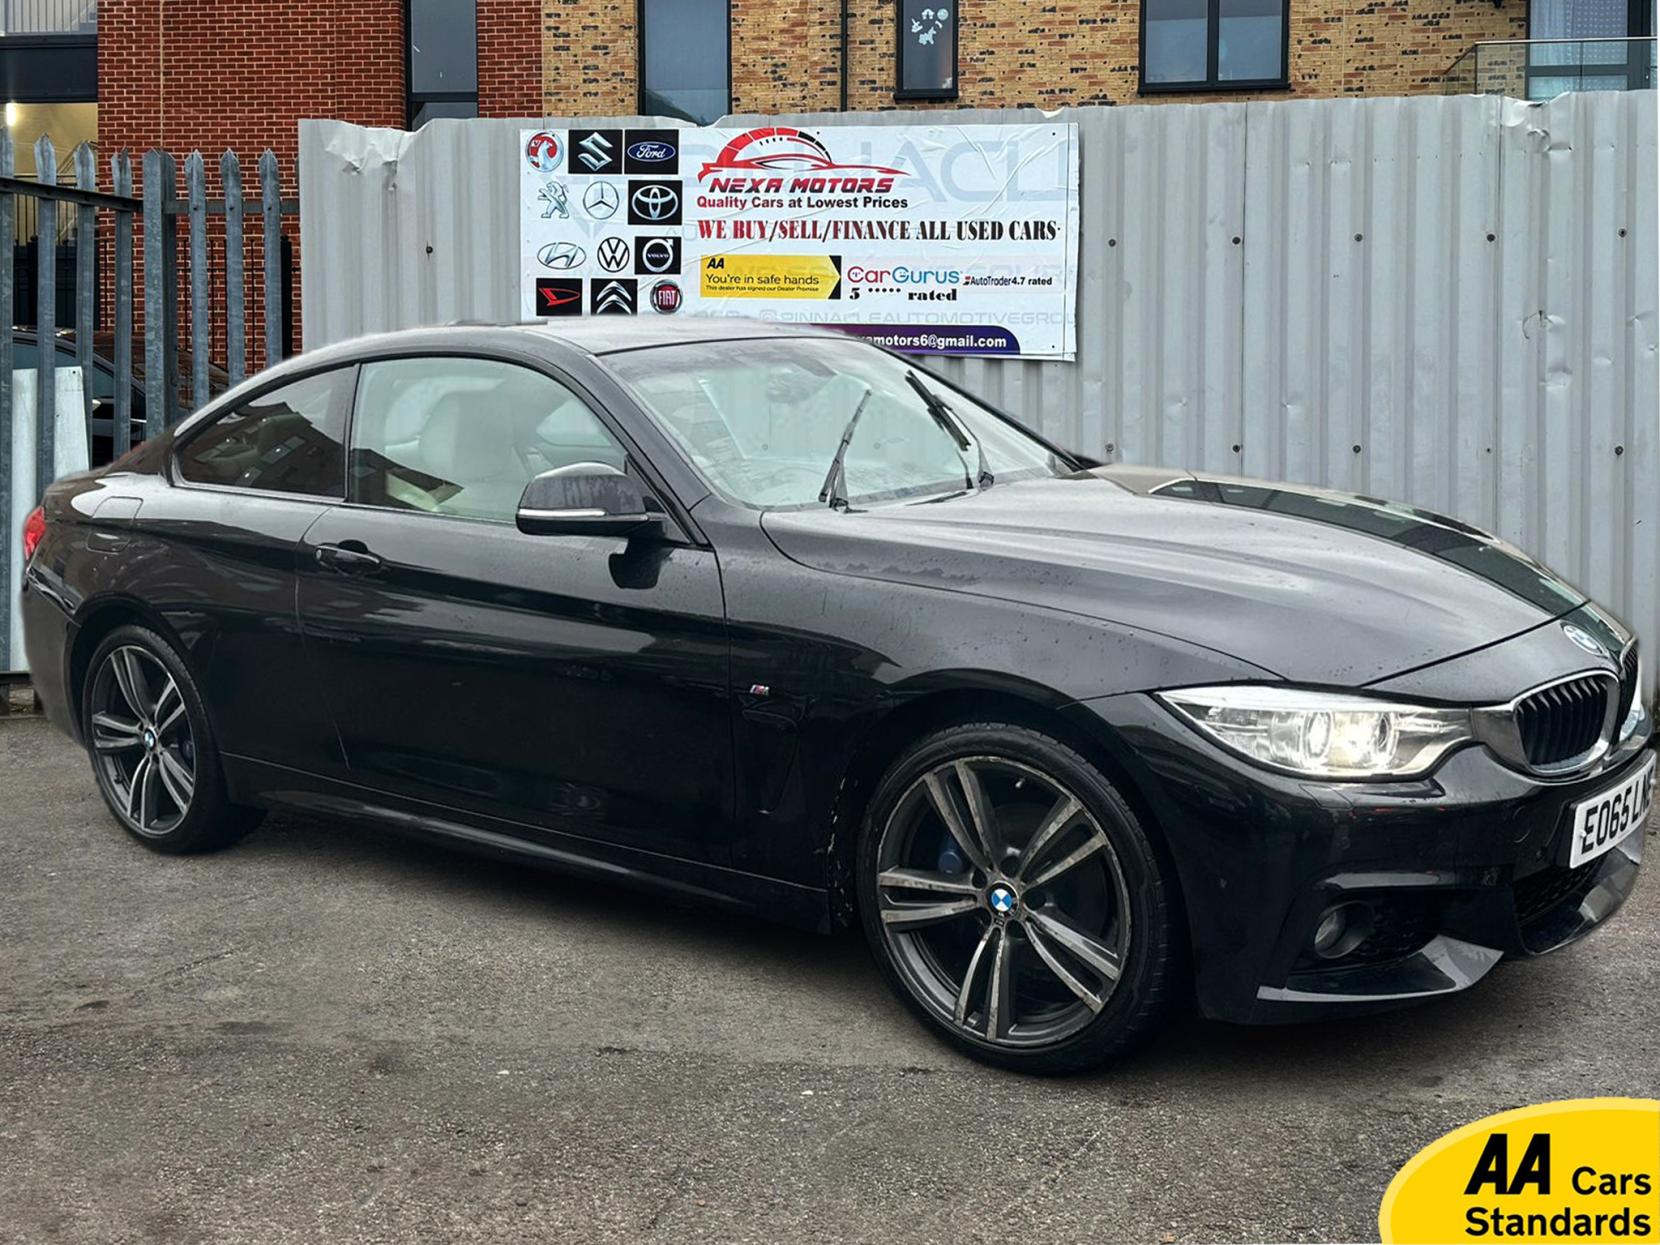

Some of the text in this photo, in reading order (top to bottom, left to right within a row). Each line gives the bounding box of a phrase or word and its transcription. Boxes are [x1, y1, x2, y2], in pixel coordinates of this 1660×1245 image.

[637, 144, 666, 159] Ford
[709, 177, 895, 194] NEXA MOTORS
[697, 196, 908, 210] Quality Cars at Lowest Prices
[697, 220, 727, 240] WE
[733, 219, 911, 243] BUY/SELL/FINANCE
[915, 220, 951, 240] ALL
[956, 219, 1004, 240] USED
[1008, 219, 1057, 241] CARS
[706, 257, 725, 269] AA
[706, 274, 820, 285] You're in safe hands
[847, 266, 960, 284] CarGurus
[970, 276, 1053, 286] AutoTrader 4.7 rated
[658, 289, 676, 305] FIAT
[849, 287, 957, 301] 5 rated
